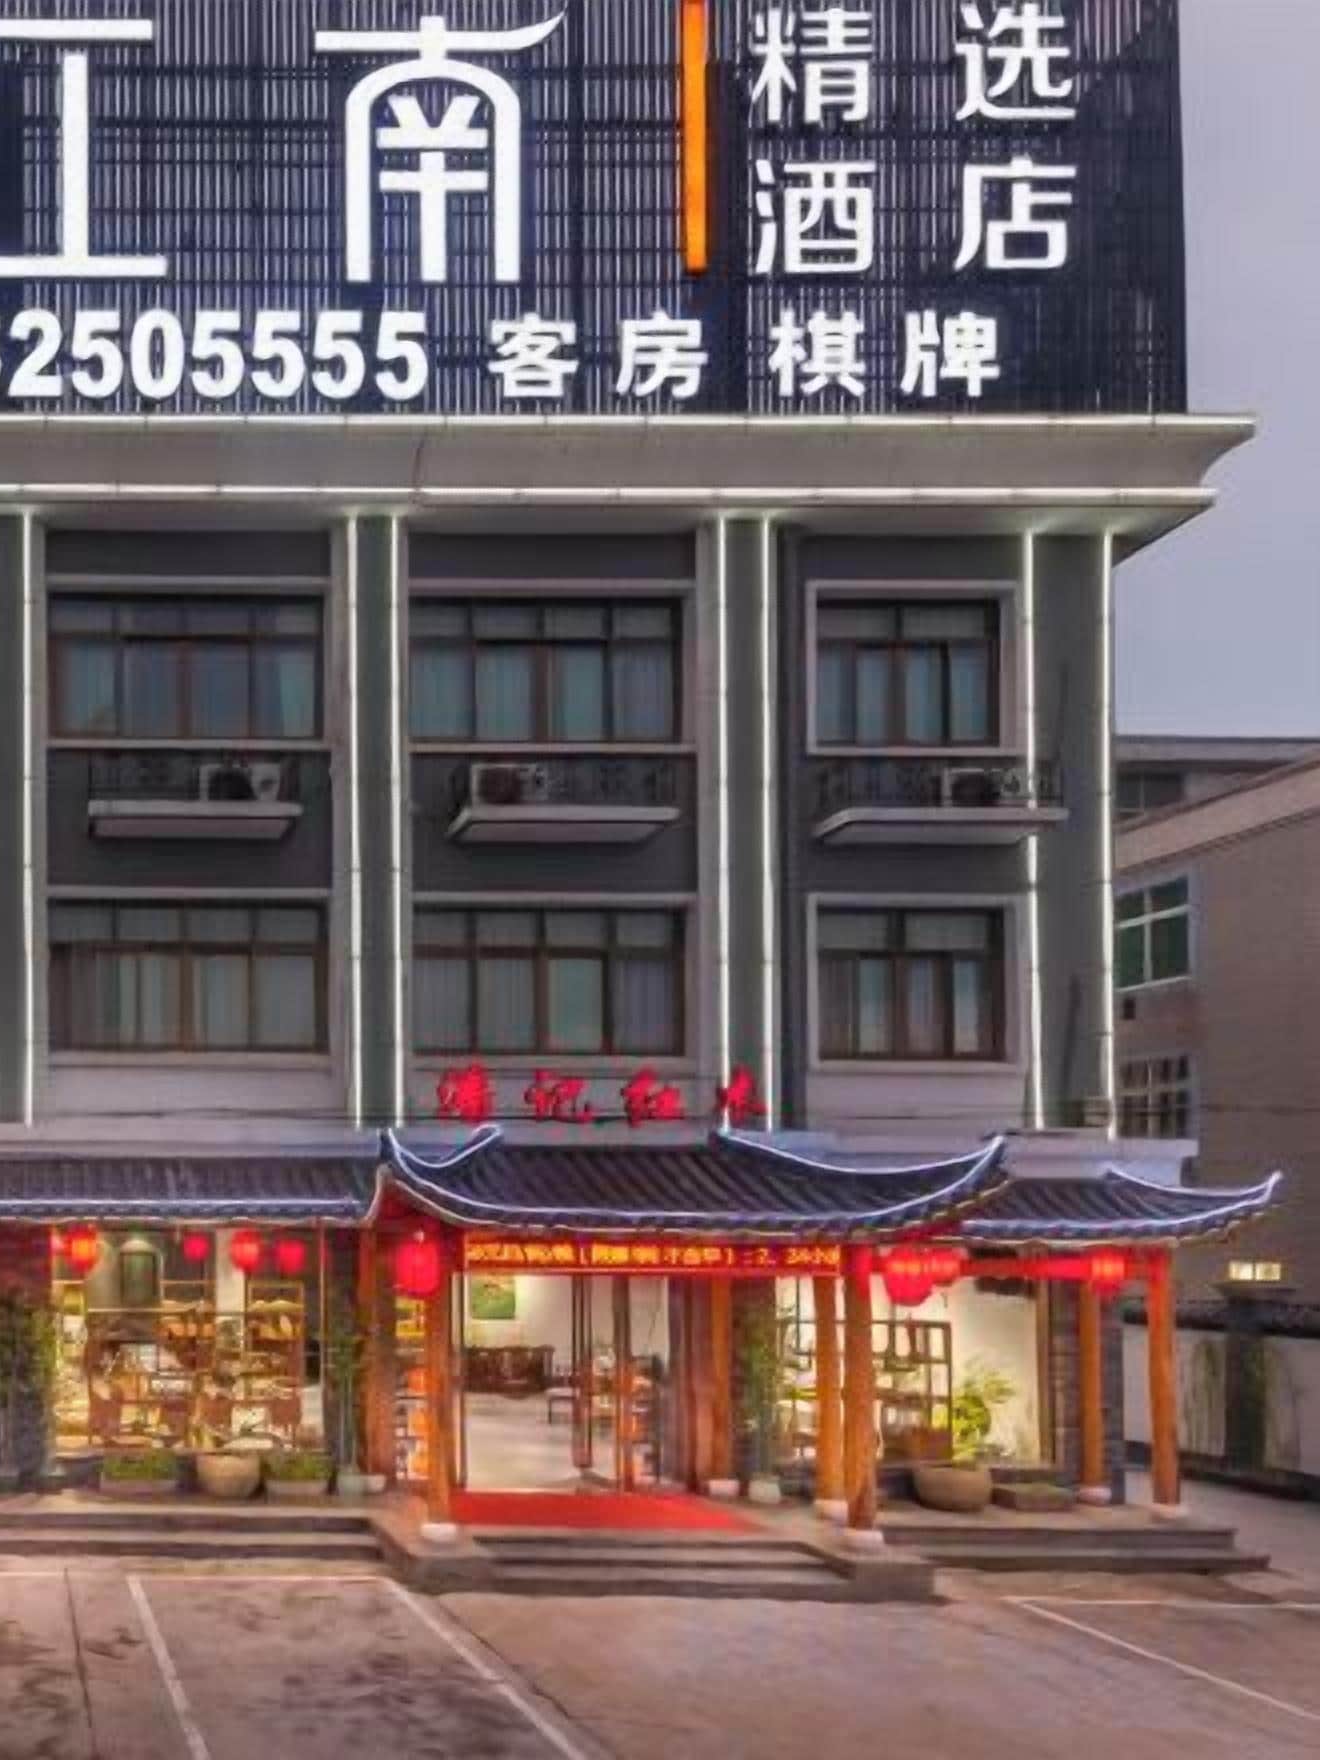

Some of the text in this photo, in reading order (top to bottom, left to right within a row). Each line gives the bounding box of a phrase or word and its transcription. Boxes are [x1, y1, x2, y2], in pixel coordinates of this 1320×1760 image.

[751, 4, 1076, 122] 精选
[755, 156, 1076, 274] 酒店
[488, 311, 1001, 397] 客房 棋牌
